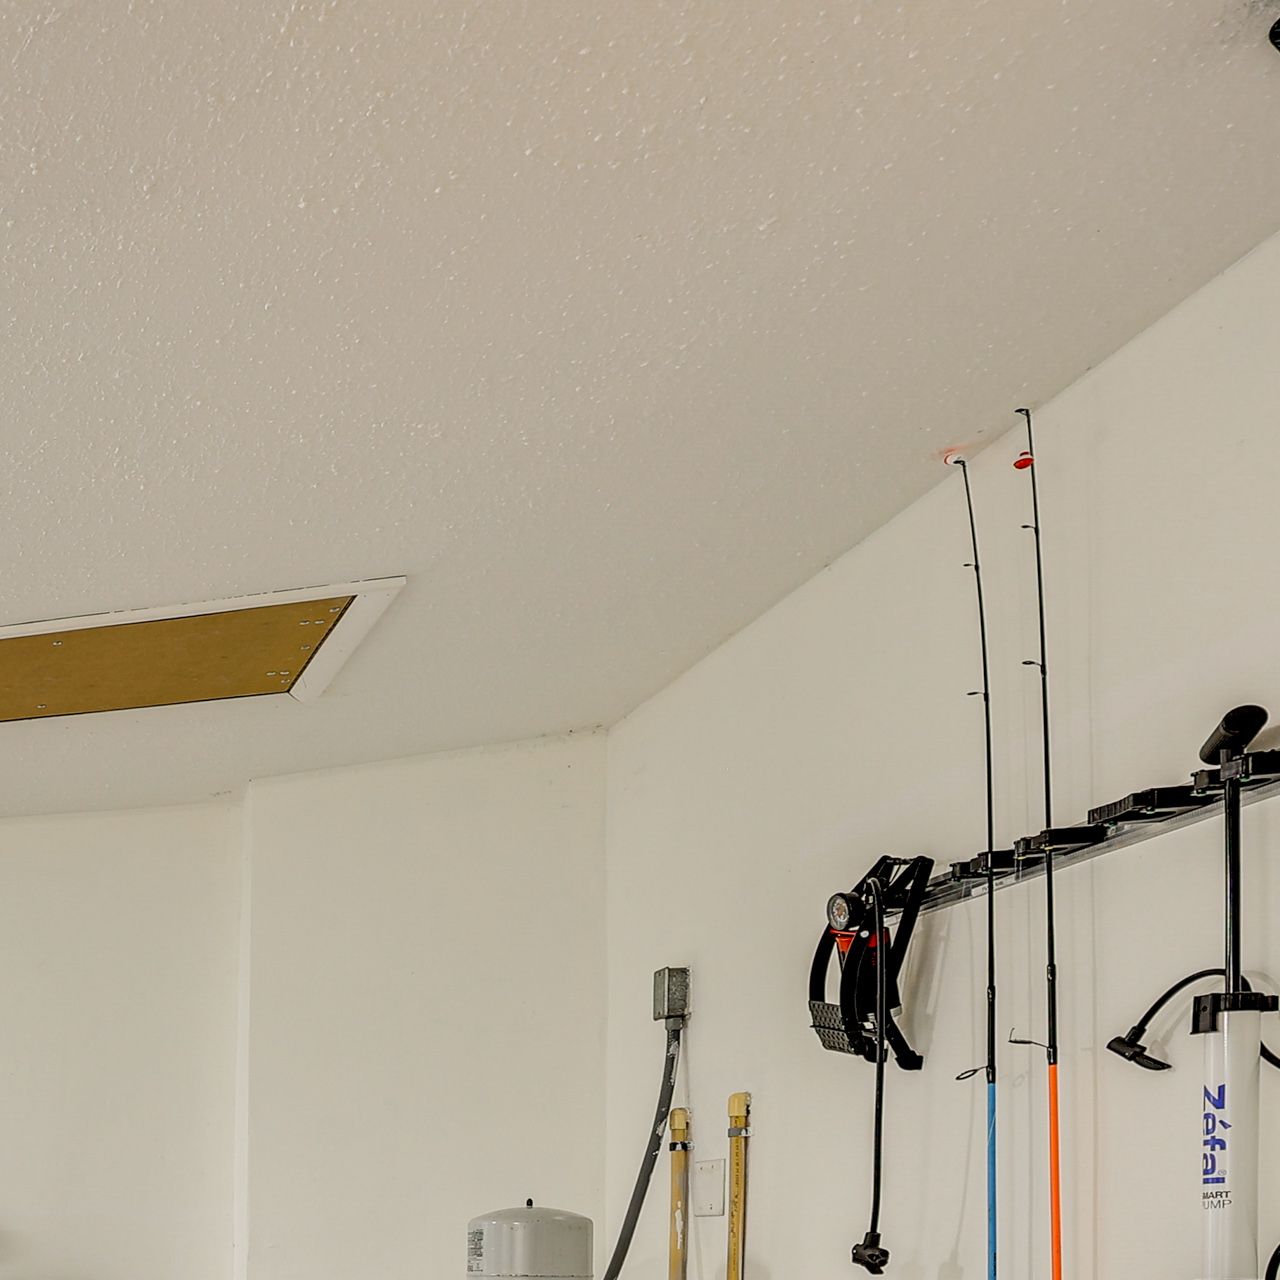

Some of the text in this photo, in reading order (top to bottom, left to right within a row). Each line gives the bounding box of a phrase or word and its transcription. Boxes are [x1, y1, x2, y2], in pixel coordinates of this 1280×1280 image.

[1202, 1083, 1232, 1184] Zéfal
[1202, 1191, 1231, 1199] MART
[1202, 1199, 1232, 1210] UMP
